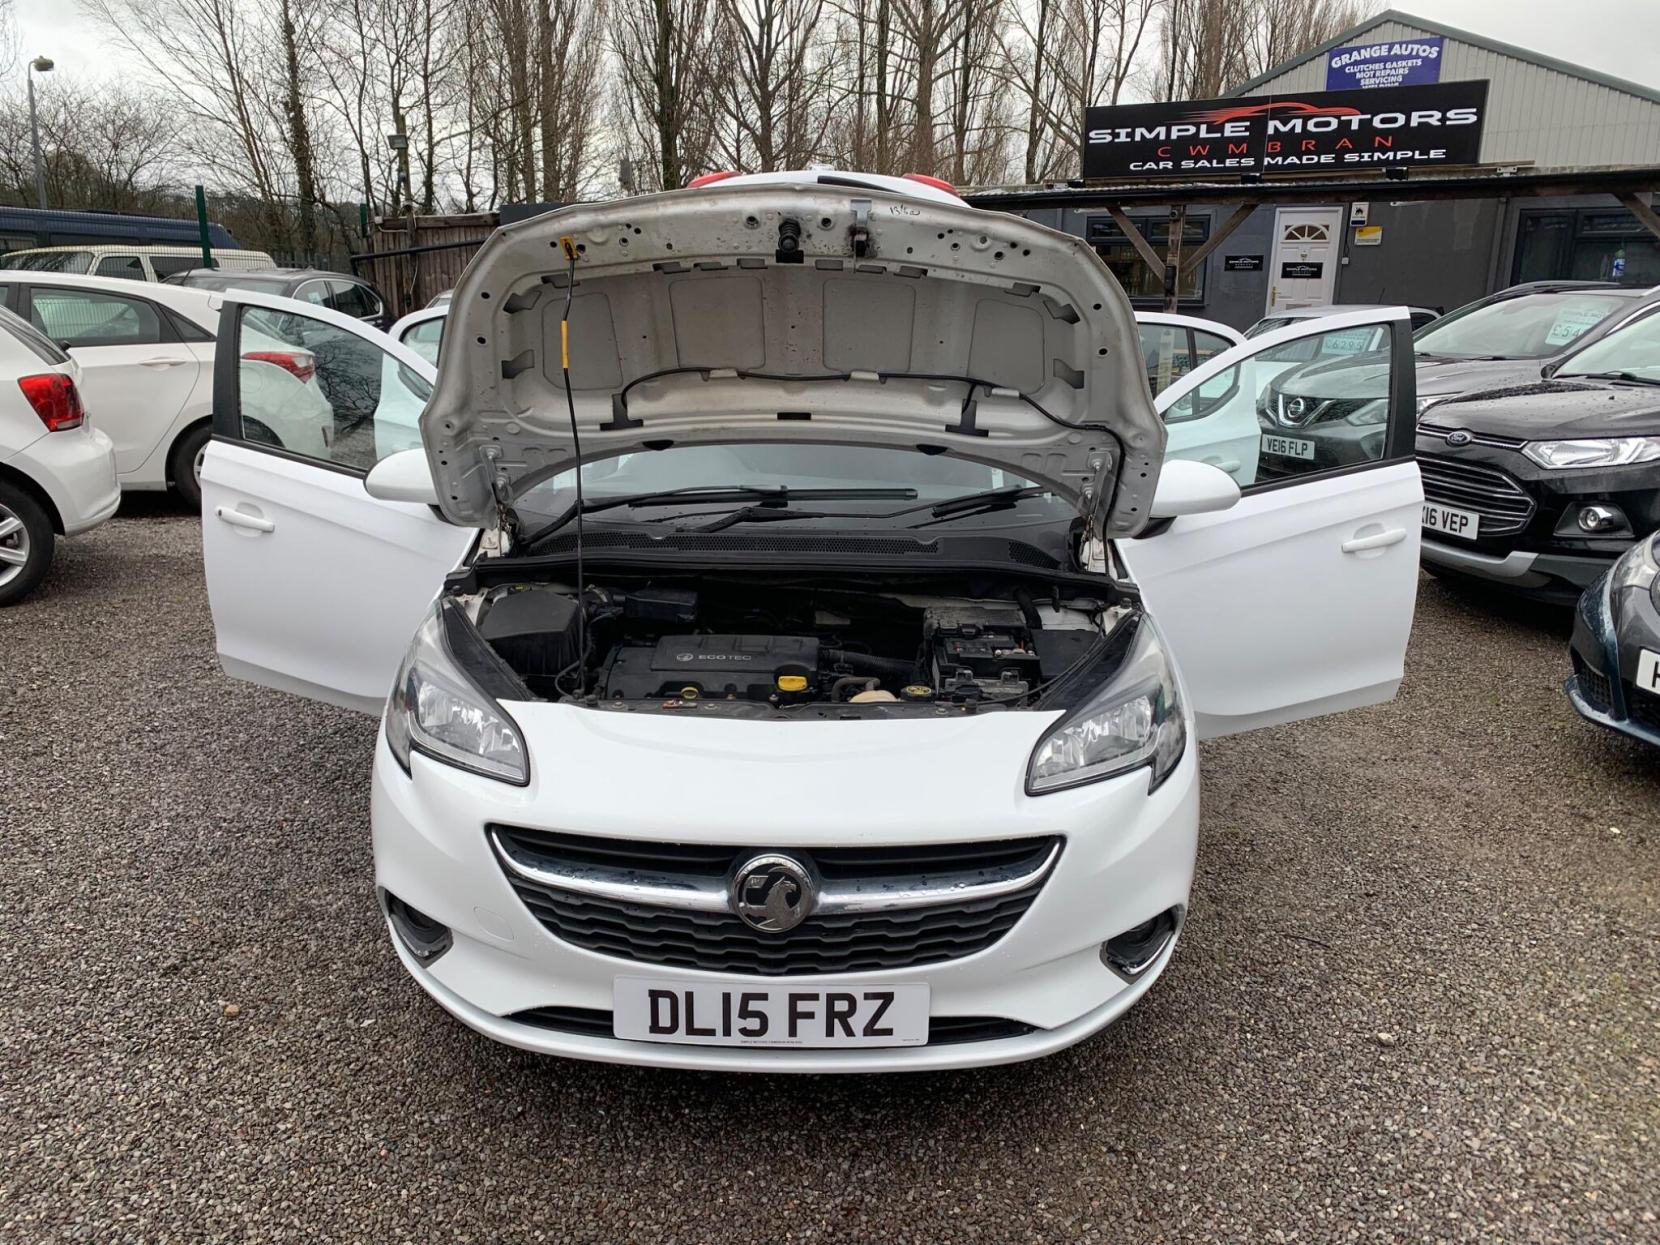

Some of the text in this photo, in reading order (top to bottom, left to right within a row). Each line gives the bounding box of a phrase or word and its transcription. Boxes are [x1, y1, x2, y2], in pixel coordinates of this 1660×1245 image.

[1331, 43, 1440, 68] GRANGE AUTOS
[1345, 59, 1422, 73] CLUTCHES GASKETS
[1356, 68, 1409, 79] MOT REPAIRS
[1360, 75, 1403, 86] SERVICING
[1088, 107, 1478, 145] SIMPLE MOTORS
[1156, 135, 1393, 158] CWMBRAN
[1129, 149, 1447, 171] CAR SALES MADE SIMPLE
[1266, 437, 1308, 456] VE16 FLP
[1442, 510, 1469, 534] VEP
[648, 988, 895, 1038] DL15 FRZ
